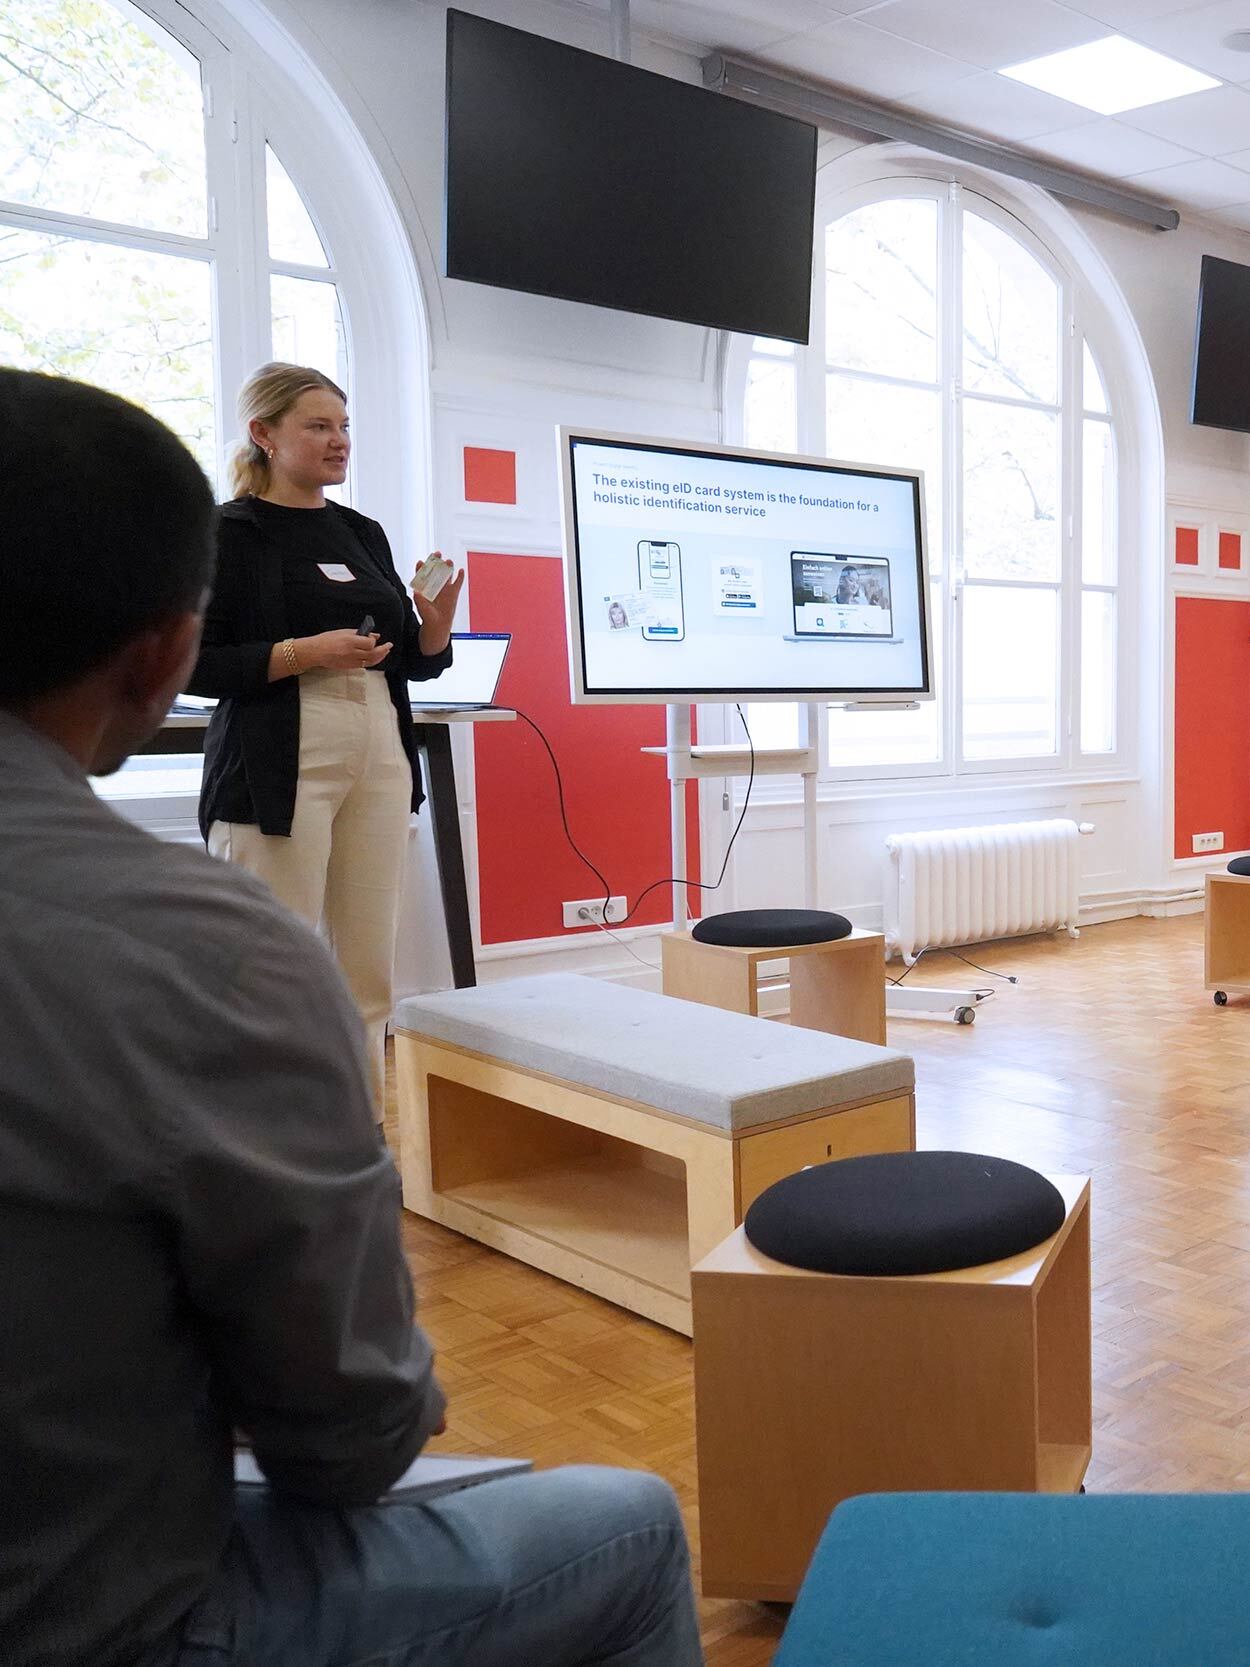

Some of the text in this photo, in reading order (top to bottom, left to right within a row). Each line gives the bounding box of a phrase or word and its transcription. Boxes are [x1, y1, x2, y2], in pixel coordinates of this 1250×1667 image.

[593, 473, 879, 513] The existing eID card system is the foundation for a
[593, 491, 766, 517] holistic identification service
